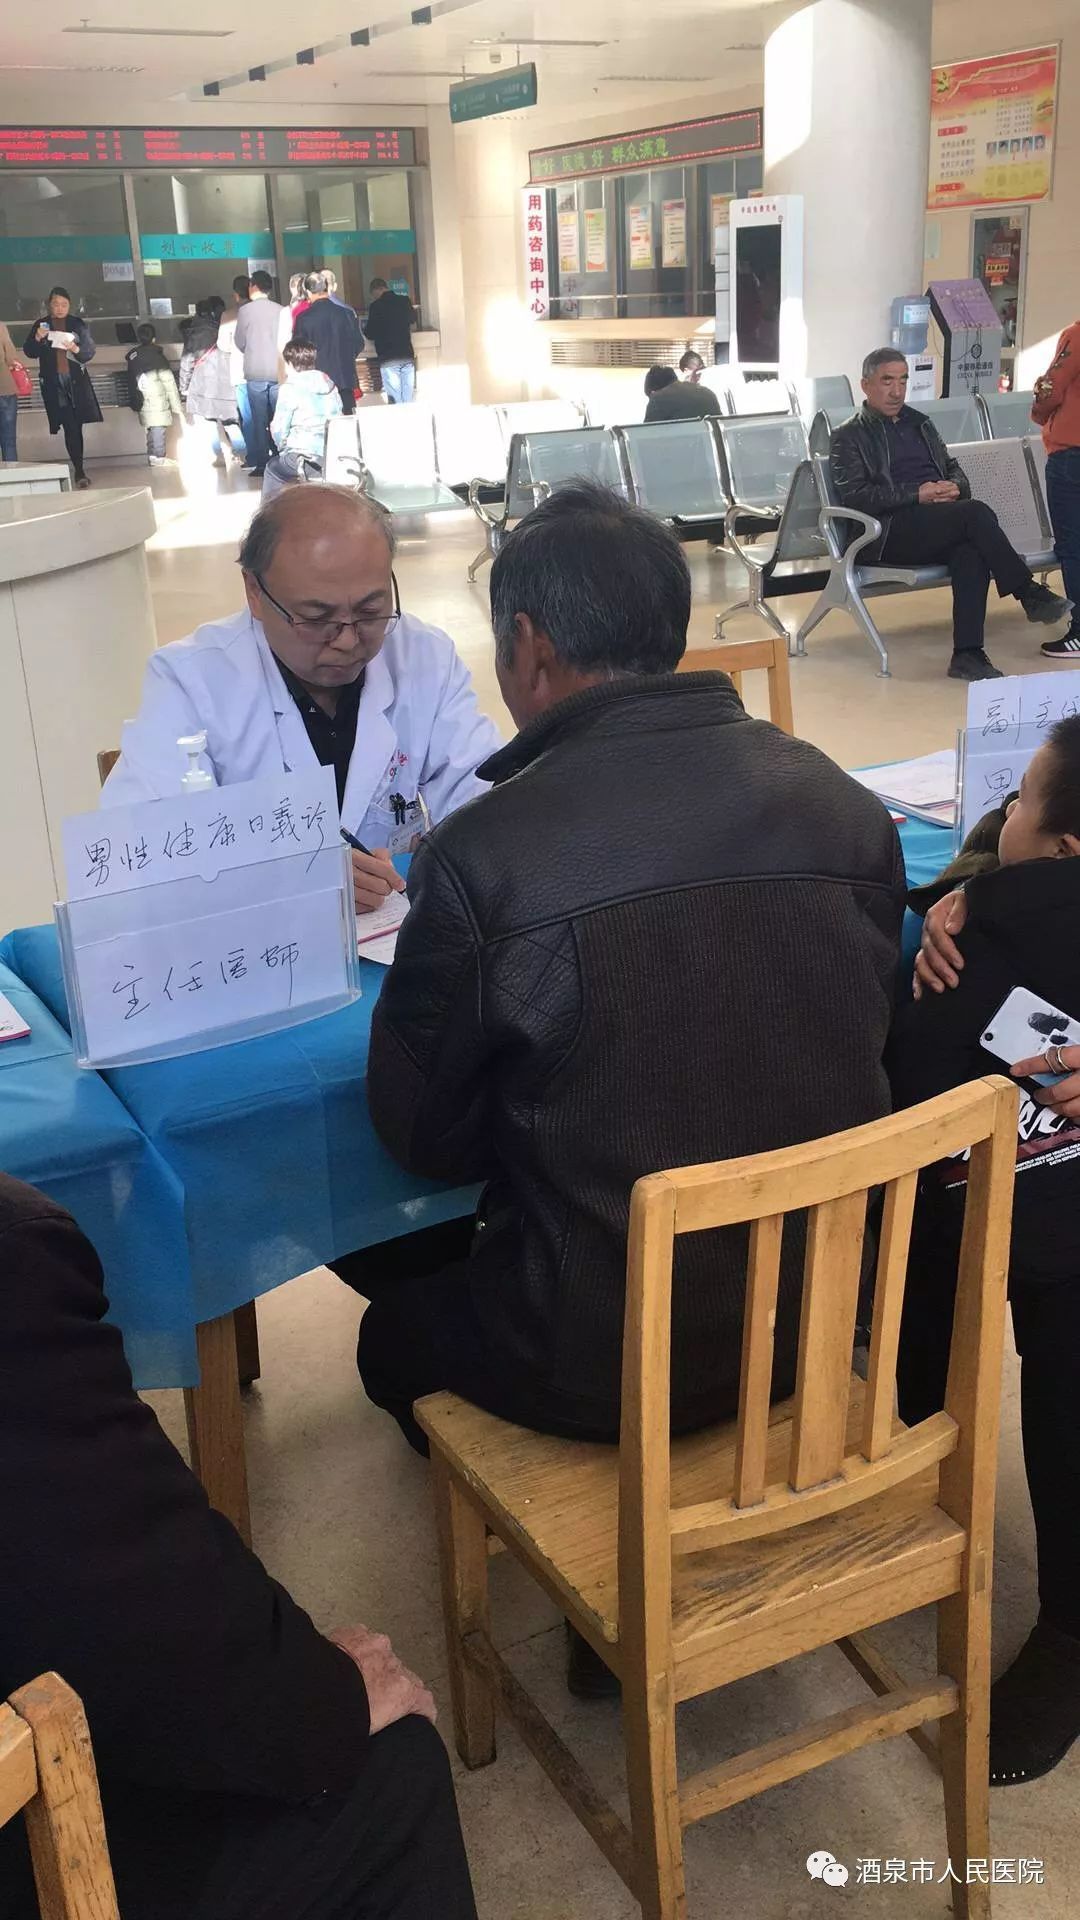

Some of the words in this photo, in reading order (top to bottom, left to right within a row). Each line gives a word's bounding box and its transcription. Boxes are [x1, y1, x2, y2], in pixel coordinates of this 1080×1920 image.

[528, 194, 546, 314] 用药咨询中心
